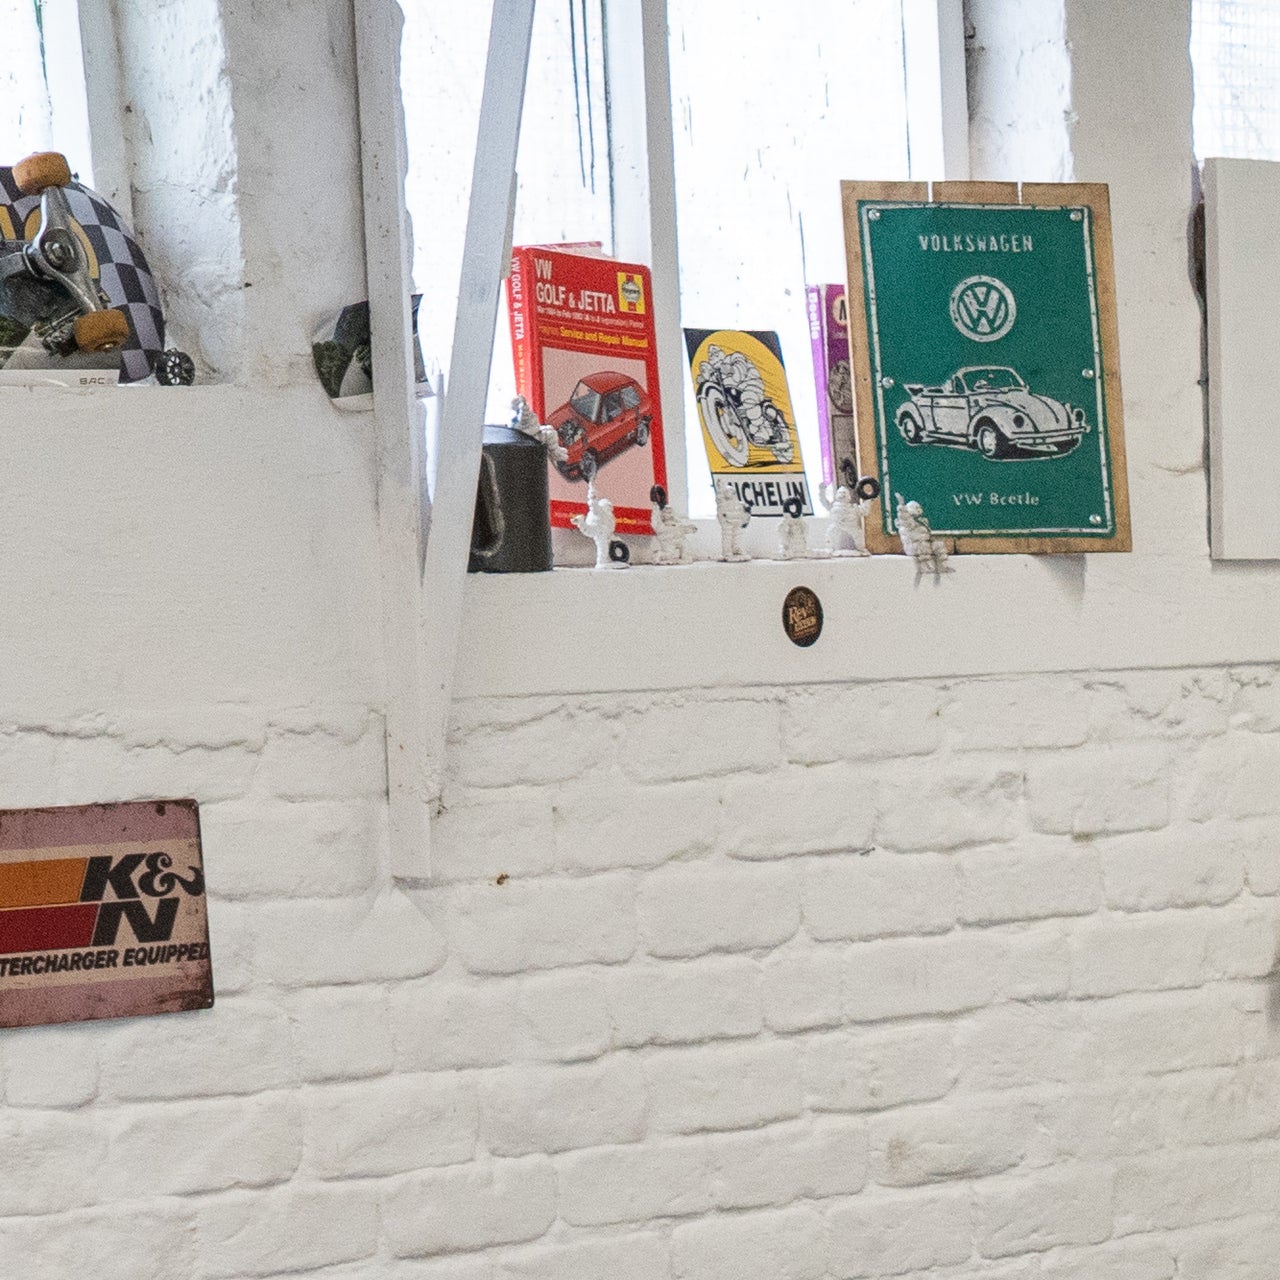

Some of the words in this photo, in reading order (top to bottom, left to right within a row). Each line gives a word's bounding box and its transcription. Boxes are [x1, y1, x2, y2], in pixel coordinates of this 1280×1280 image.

[918, 234, 1034, 253] VOLKSWAGEN
[534, 258, 553, 280] VW
[536, 282, 566, 306] GOLF
[568, 296, 576, 309] &
[578, 290, 616, 314] JETTA
[514, 311, 525, 341] JETTA
[953, 493, 982, 505] VW
[989, 491, 1040, 506] Beetle
